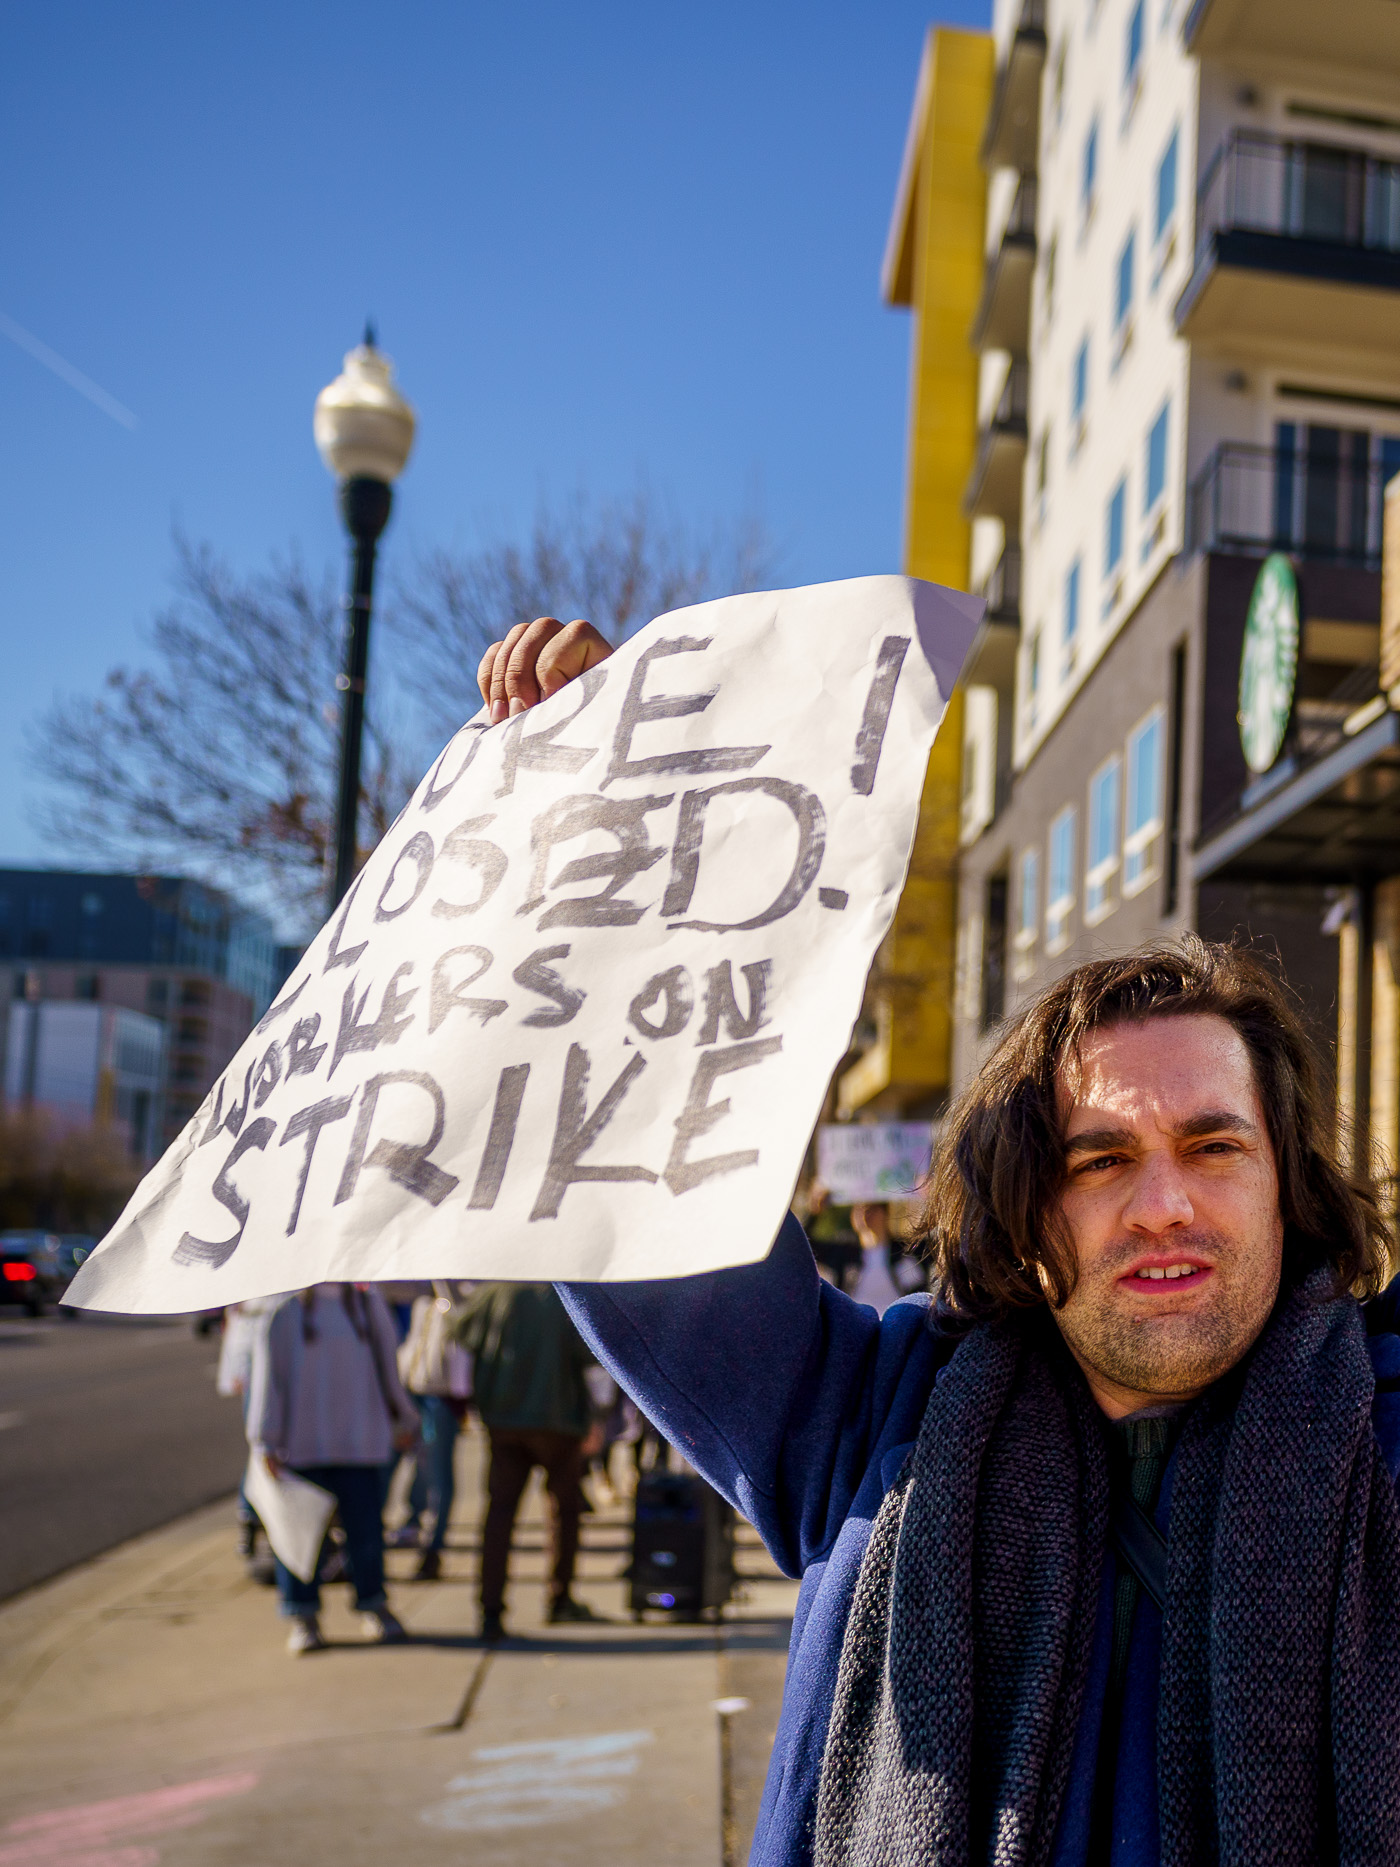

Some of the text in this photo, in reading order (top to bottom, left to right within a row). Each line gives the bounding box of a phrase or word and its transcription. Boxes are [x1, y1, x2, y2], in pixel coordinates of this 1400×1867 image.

[171, 1034, 783, 1270] STRIKE
[199, 944, 773, 1147] WORKERS ON
